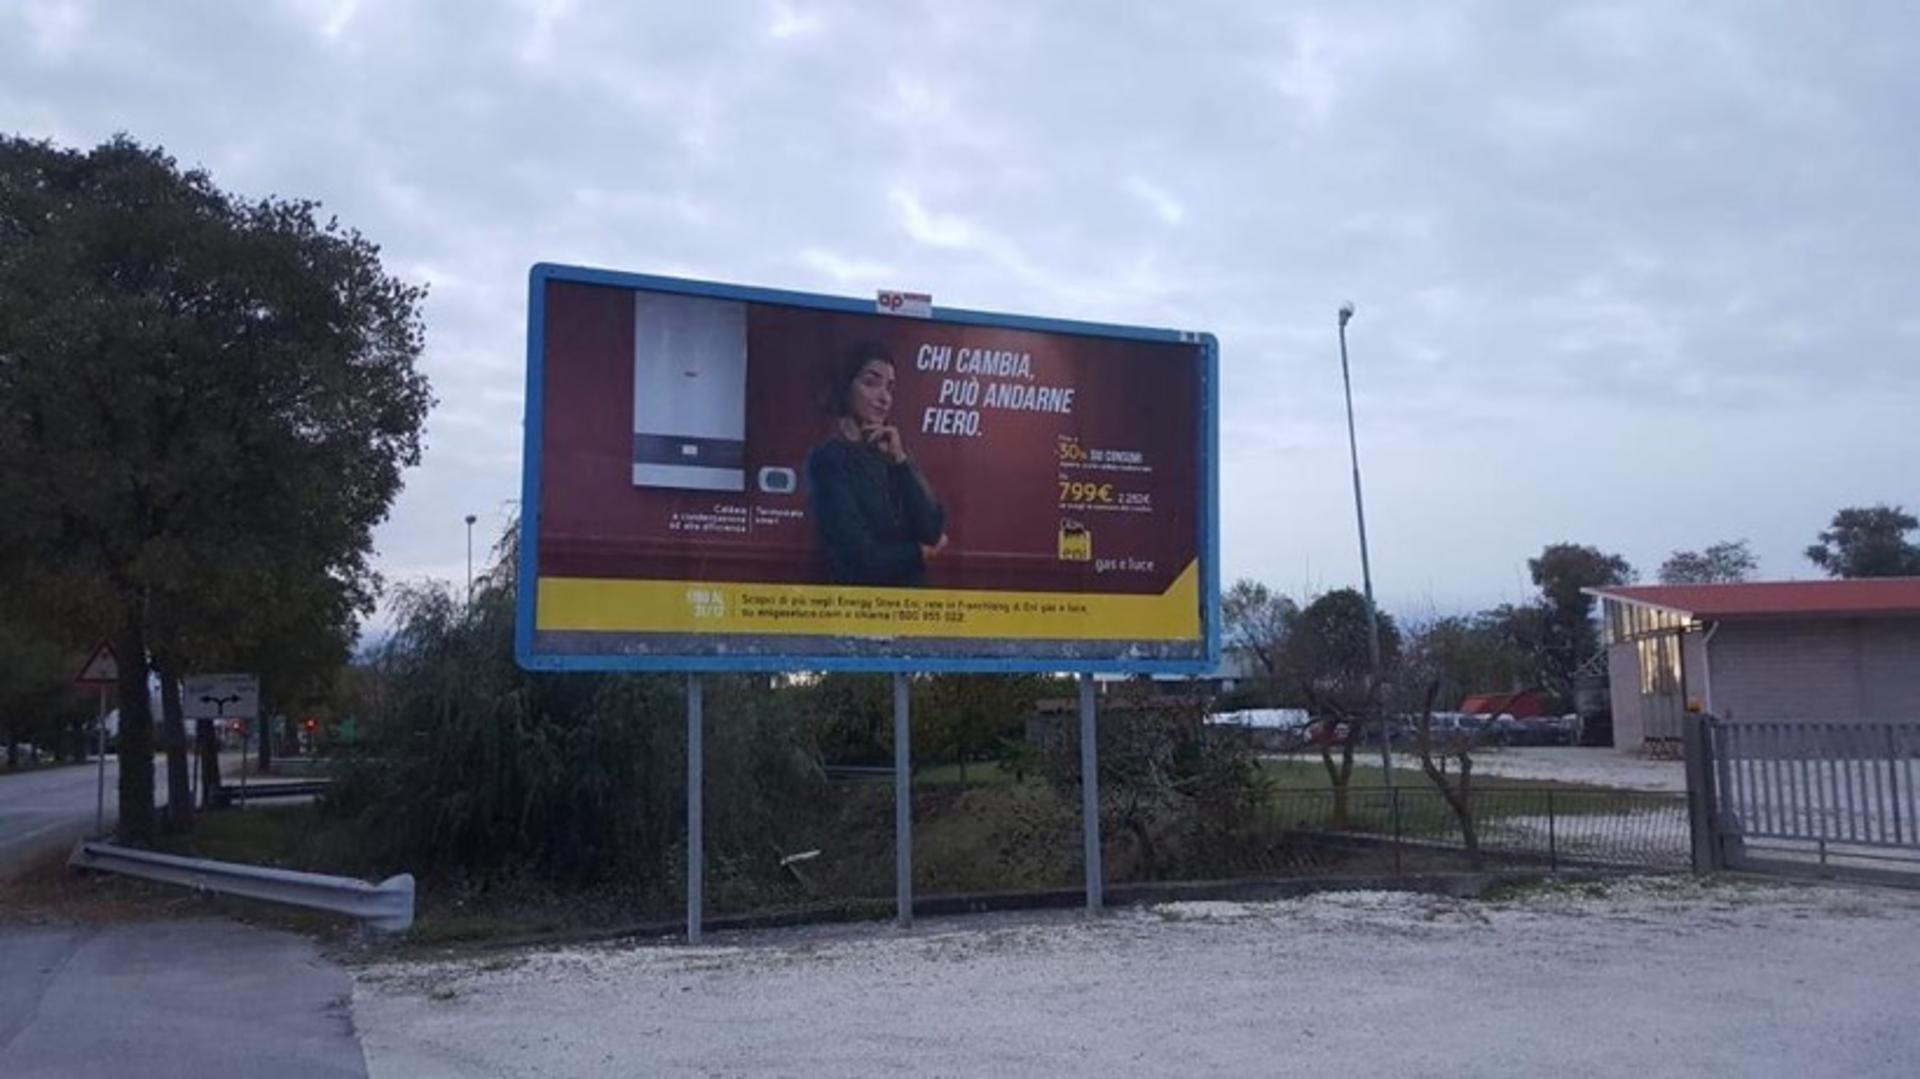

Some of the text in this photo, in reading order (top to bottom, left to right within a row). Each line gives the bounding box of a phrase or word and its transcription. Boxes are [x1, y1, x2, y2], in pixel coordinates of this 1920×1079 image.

[916, 343, 1035, 381] CHI CAMBIA,
[938, 376, 1075, 414] PUÒ ANDARNE
[921, 406, 983, 437] FIERO.
[1058, 481, 1113, 503] 799€
[1095, 556, 1155, 574] gas e luce
